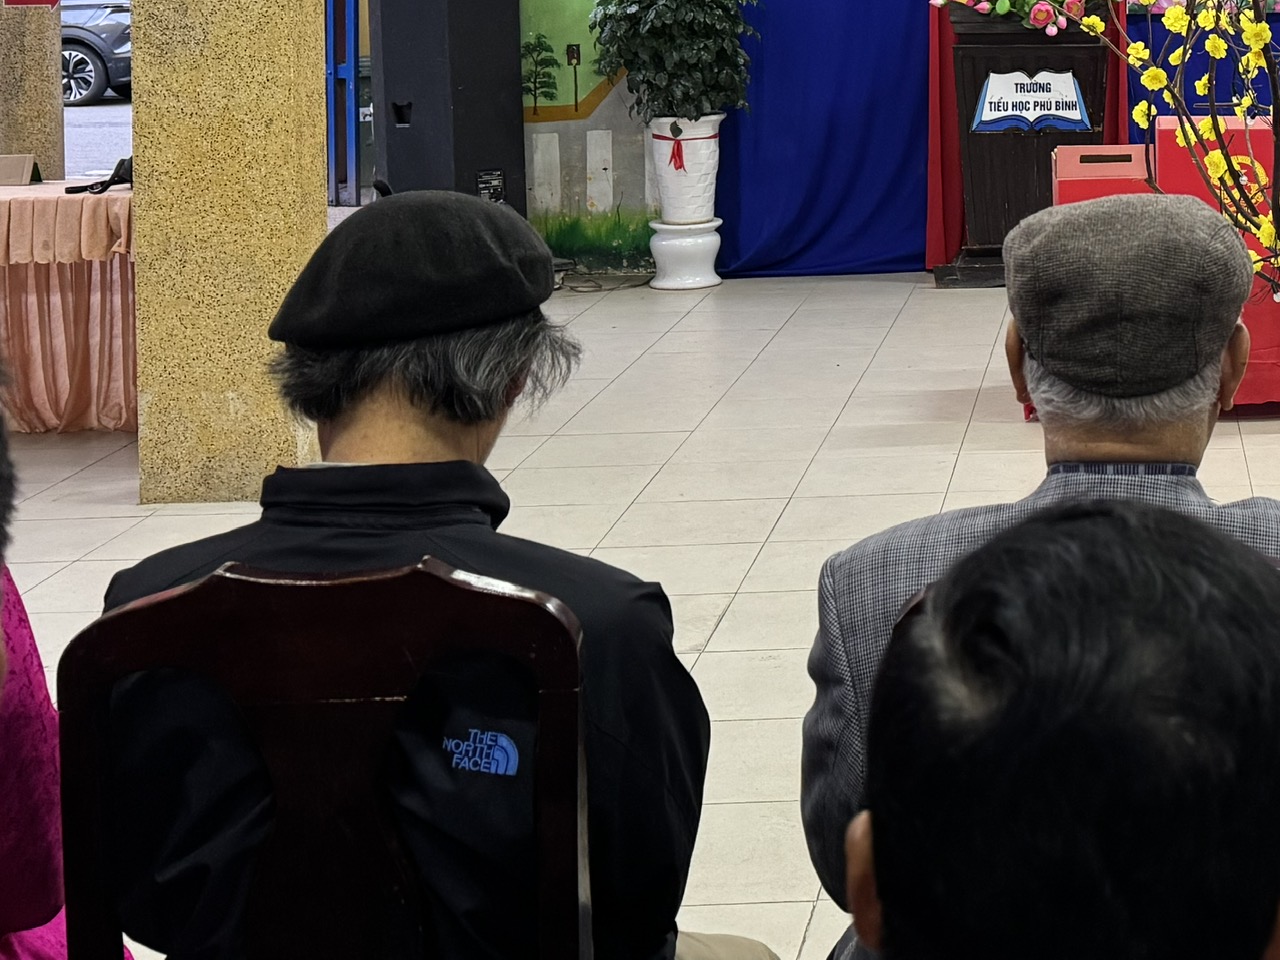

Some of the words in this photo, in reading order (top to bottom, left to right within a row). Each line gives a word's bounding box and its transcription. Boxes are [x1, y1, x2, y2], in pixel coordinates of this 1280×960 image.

[1014, 80, 1052, 94] TRƯỜNG
[988, 97, 1008, 112] TIỂU
[1011, 101, 1030, 114] HỌC
[1033, 98, 1052, 111] PHÚ
[1055, 98, 1077, 111] BÌNH
[468, 728, 497, 745] THE
[442, 736, 494, 761] NORTH
[452, 753, 492, 773] FACE
